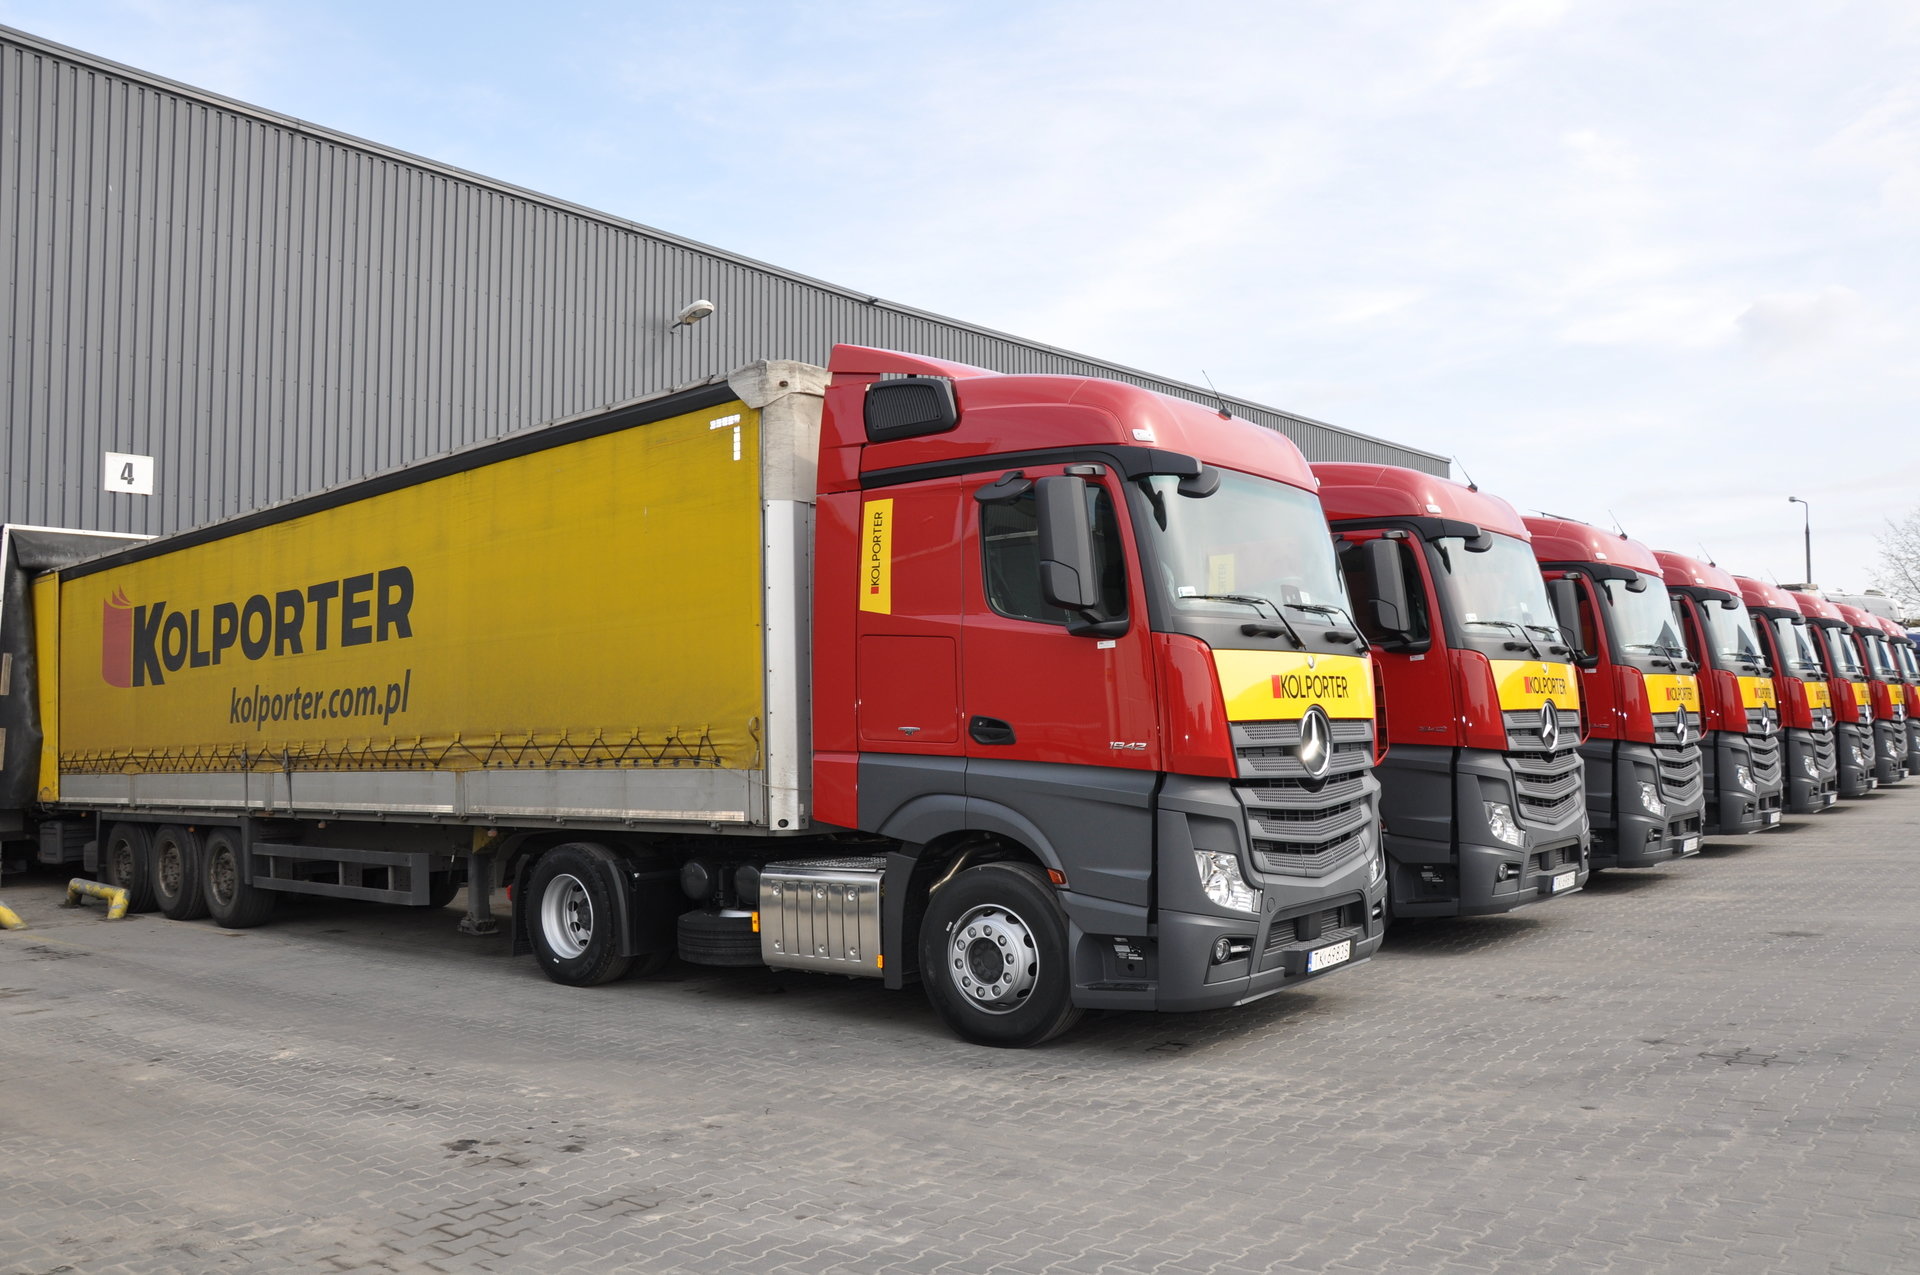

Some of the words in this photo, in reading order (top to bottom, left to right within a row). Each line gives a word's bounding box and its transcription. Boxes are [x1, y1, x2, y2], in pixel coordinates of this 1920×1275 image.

[120, 462, 135, 485] 4
[870, 511, 884, 586] KOLPORTER
[132, 565, 415, 688] KOLPORTER
[229, 668, 412, 732] kolporter.com.pl
[1280, 674, 1349, 699] KOLPORTER
[1529, 676, 1567, 695] KOLPORTER
